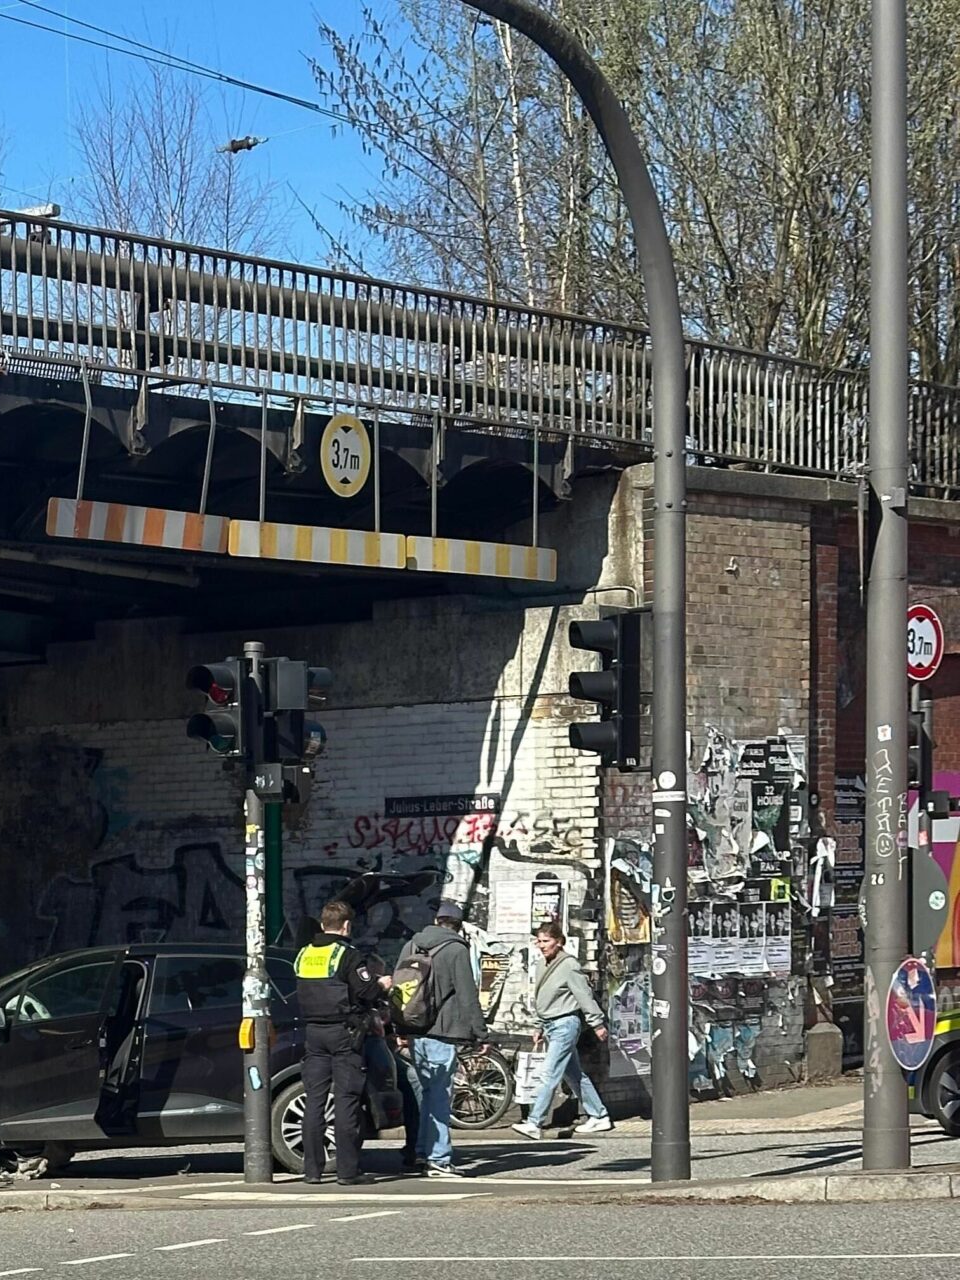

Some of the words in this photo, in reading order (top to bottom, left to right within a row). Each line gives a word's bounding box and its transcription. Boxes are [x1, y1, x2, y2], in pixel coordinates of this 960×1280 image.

[764, 785, 775, 795] 32
[390, 796, 495, 814] Julius-Leber-Straße
[757, 795, 784, 806] HOURS
[871, 873, 885, 886] 26
